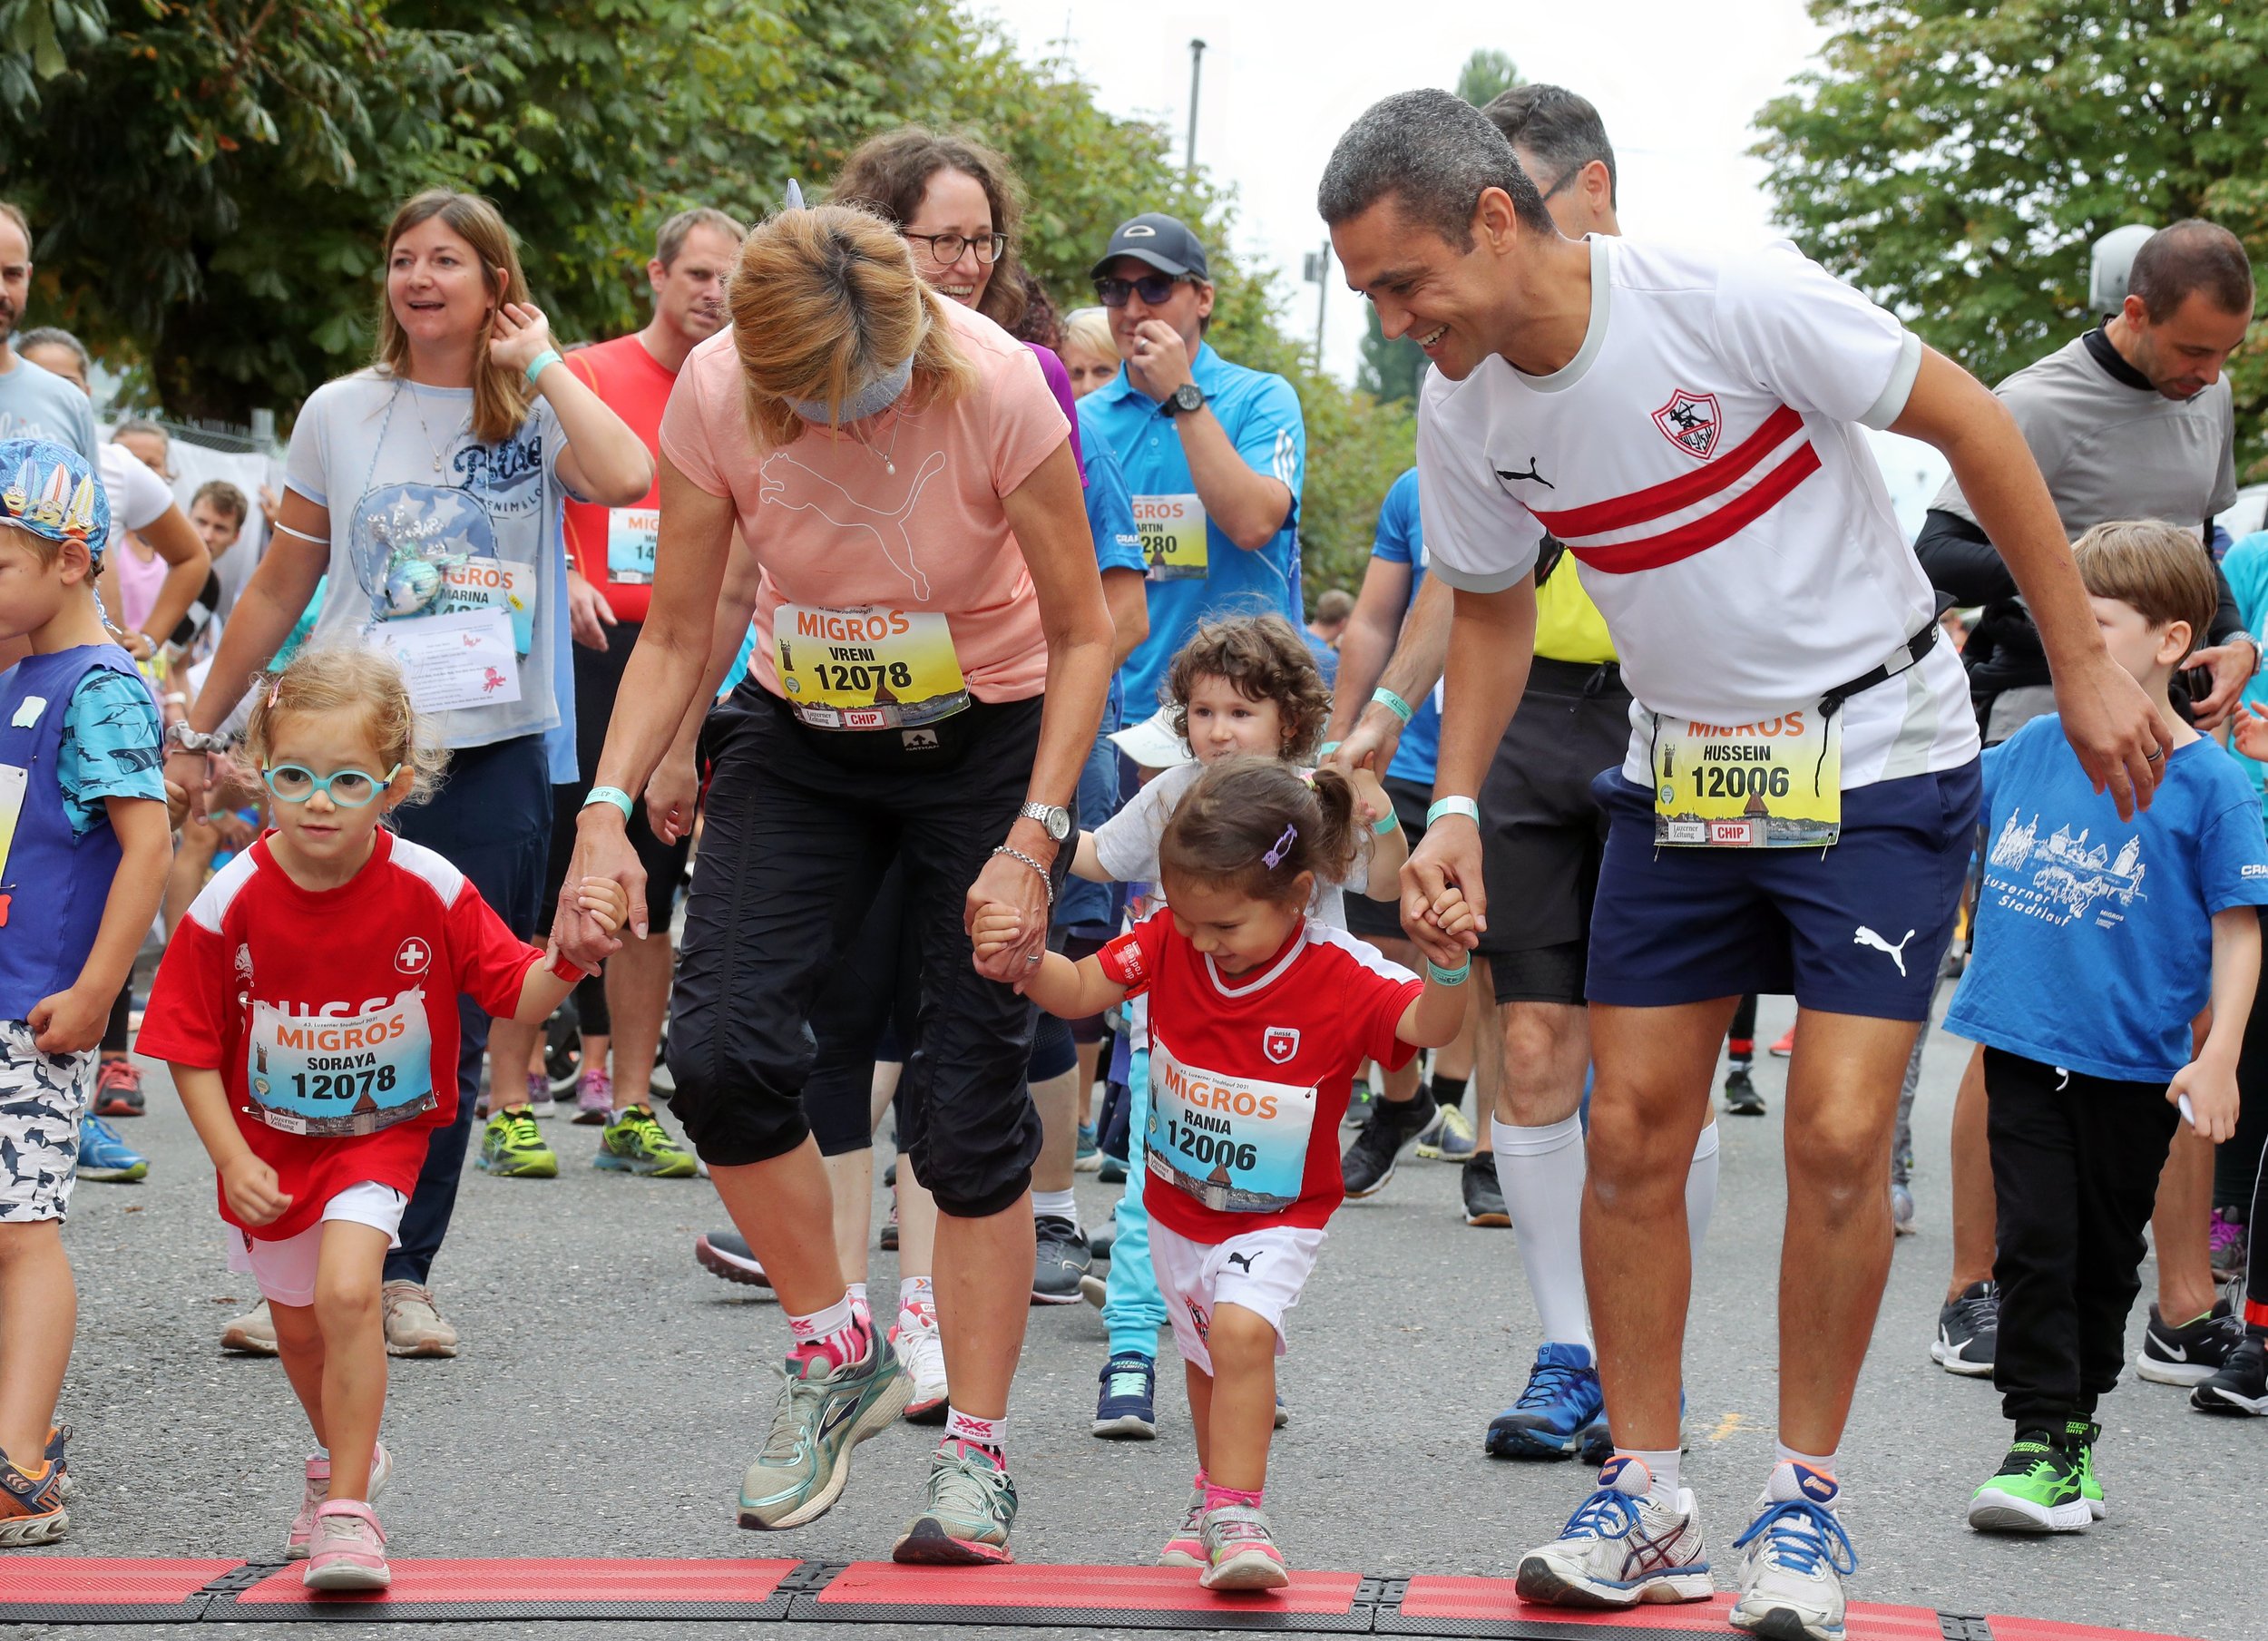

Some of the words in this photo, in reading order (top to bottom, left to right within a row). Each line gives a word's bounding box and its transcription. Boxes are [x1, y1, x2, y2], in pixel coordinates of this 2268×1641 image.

[439, 588, 490, 604] MARINA
[797, 609, 911, 642] MIGROS
[828, 646, 876, 662] VRENI
[813, 661, 913, 691] 12078
[850, 713, 878, 725] CHIP
[1703, 745, 1772, 762] HUSSEIN
[1691, 766, 1791, 798] 12006
[1672, 824, 1699, 833] Luzerner
[1672, 830, 1696, 840] Zeitung
[1716, 826, 1745, 840] CHIP
[1983, 874, 2051, 905] Luzerner
[1998, 894, 2072, 927] Stadtlauf
[1123, 943, 1143, 976] rodtegg
[277, 1013, 406, 1052] MIGROS
[307, 1051, 377, 1071] SORAYA
[291, 1064, 396, 1100] 12078
[1188, 1071, 1212, 1082] Luzerner
[1212, 1078, 1236, 1089] Stadtlauf
[1236, 1081, 1250, 1090] 2021
[1164, 1063, 1279, 1120] MIGROS
[269, 1113, 300, 1128] Luzerner
[269, 1118, 296, 1132] Zeitung
[1184, 1109, 1232, 1136] RANIA
[1168, 1118, 1257, 1171] 12006
[1110, 1360, 1149, 1369] SKECHERS
